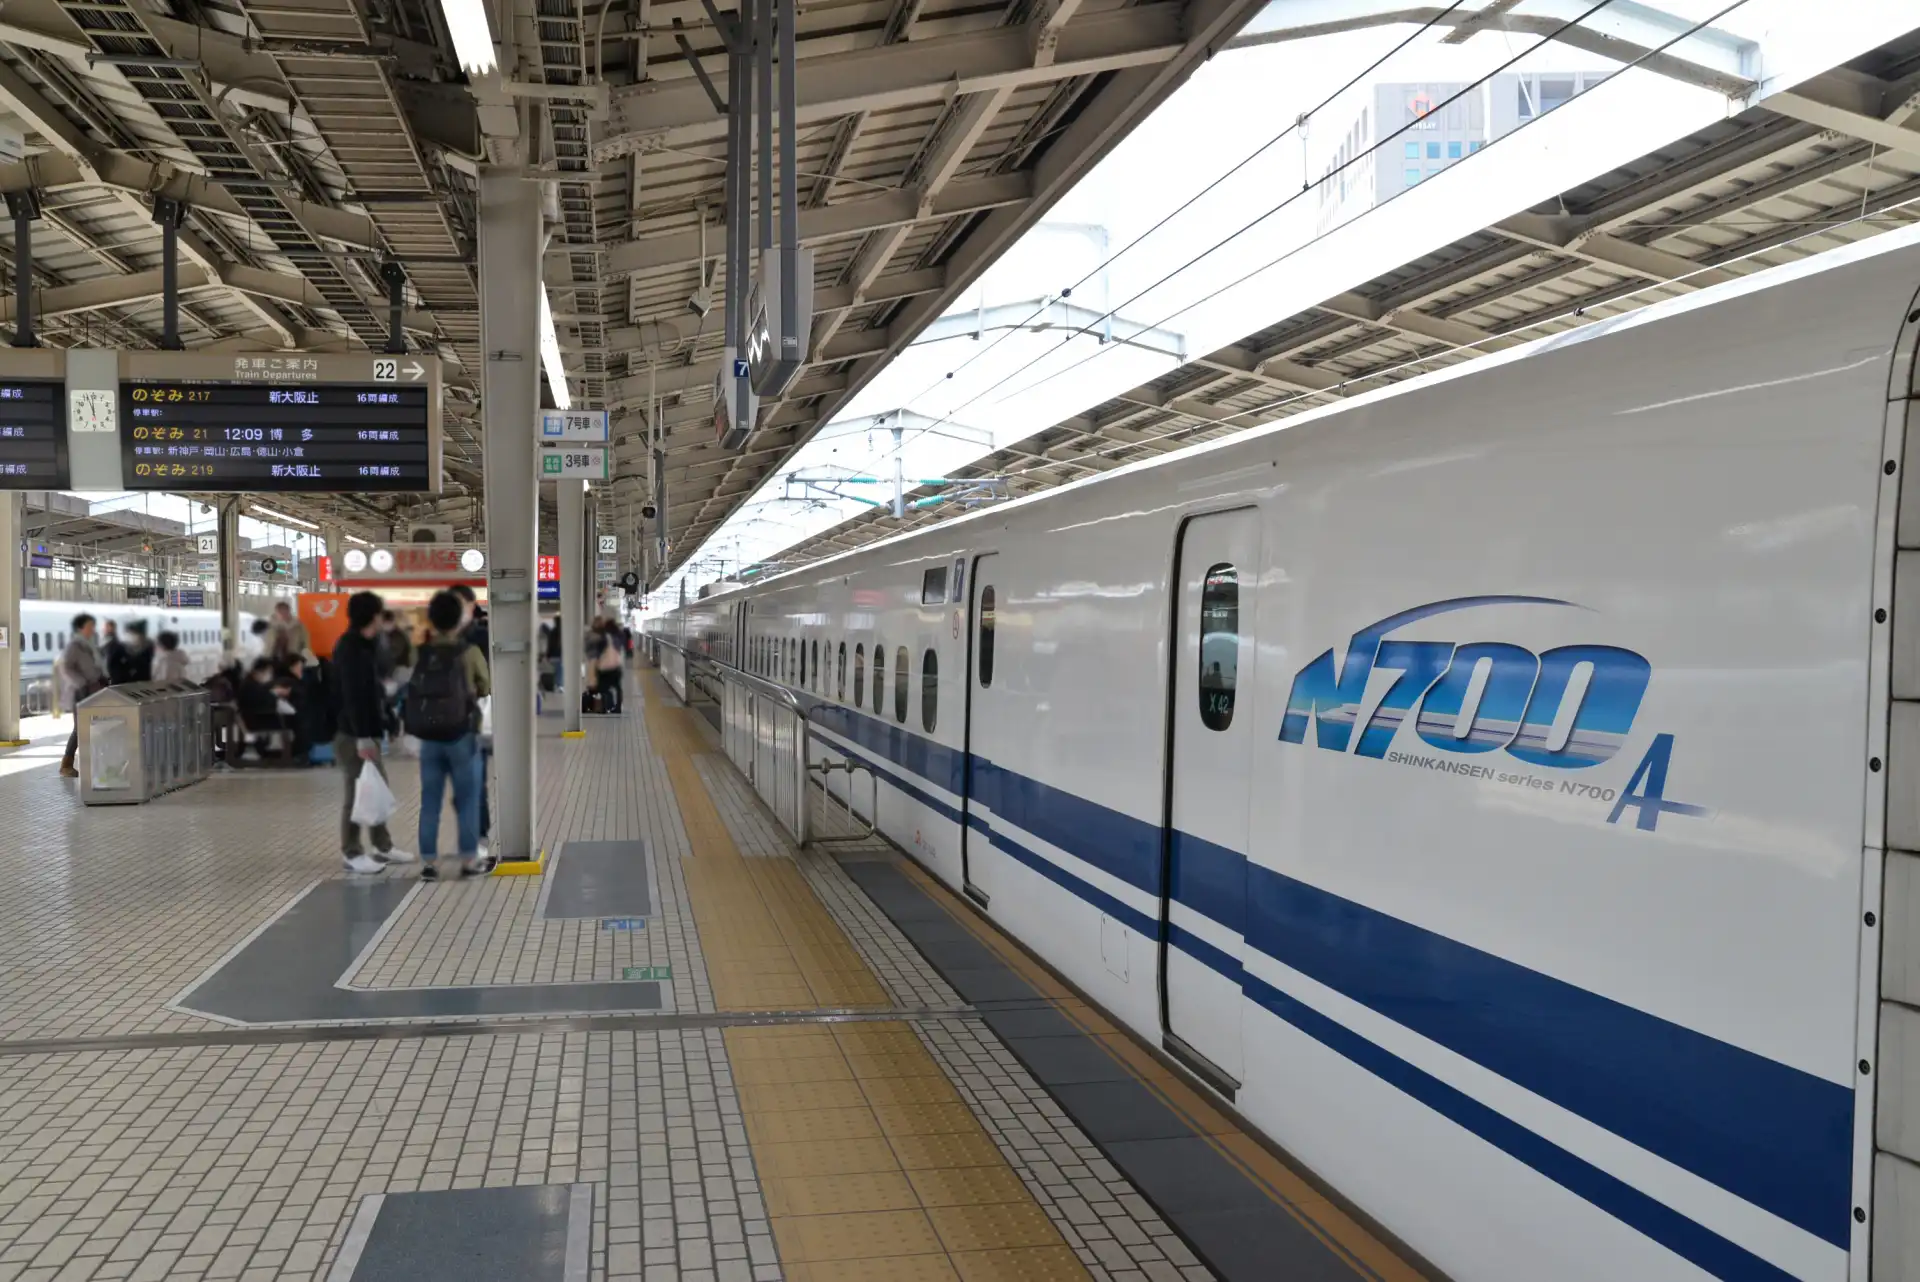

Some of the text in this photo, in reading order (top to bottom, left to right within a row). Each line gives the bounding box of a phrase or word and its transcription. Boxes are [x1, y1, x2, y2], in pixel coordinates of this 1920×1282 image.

[235, 358, 318, 369] 発車ご案内
[375, 362, 396, 379] 22
[738, 361, 748, 376] 7
[235, 370, 317, 380] Train Departures
[132, 388, 183, 402] のぞみ
[188, 391, 211, 401] 217
[269, 391, 319, 403] 新大阪止
[566, 417, 590, 430] 7号車
[0, 427, 25, 437] 編成
[133, 426, 184, 440] のぞみ
[193, 428, 208, 439] 21
[224, 428, 263, 440] 12:09
[565, 454, 590, 468] 3号車
[135, 463, 186, 476] のぞみ
[191, 465, 214, 476] 219
[271, 465, 321, 477] 新大阪止
[202, 539, 214, 550] 21
[602, 539, 614, 550] 22
[1218, 694, 1229, 714] 42
[1278, 625, 1702, 832] N700 A
[1387, 751, 1616, 802] SHINKANSEN series N700
